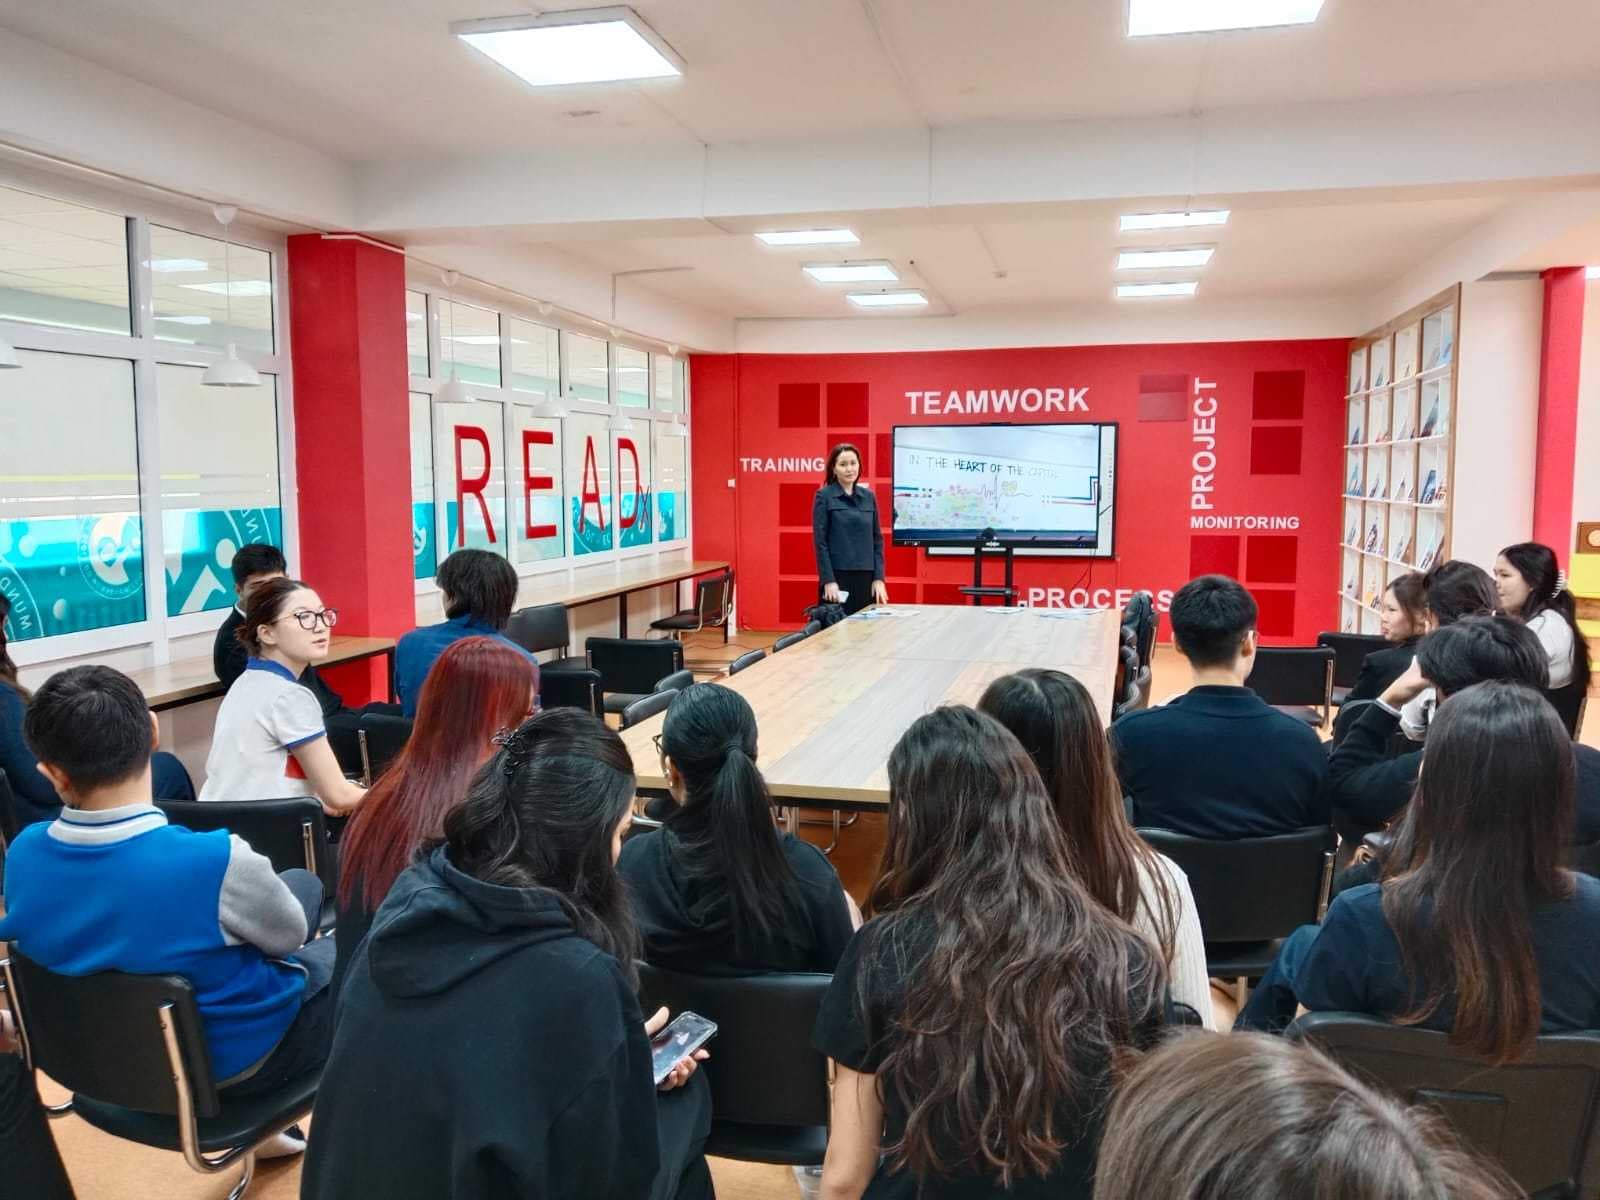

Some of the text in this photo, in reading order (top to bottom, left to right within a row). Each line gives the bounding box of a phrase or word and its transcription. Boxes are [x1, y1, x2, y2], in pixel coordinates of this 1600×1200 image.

[906, 388, 1090, 414] TEAMWORK
[1191, 376, 1218, 511] PROJECT
[741, 457, 826, 473] TRAINING
[927, 456, 948, 469] THE
[954, 458, 987, 473] HEART
[990, 463, 1002, 473] OF
[1008, 465, 1025, 476] THE
[455, 425, 640, 547] READ
[1190, 515, 1300, 530] MONITORING
